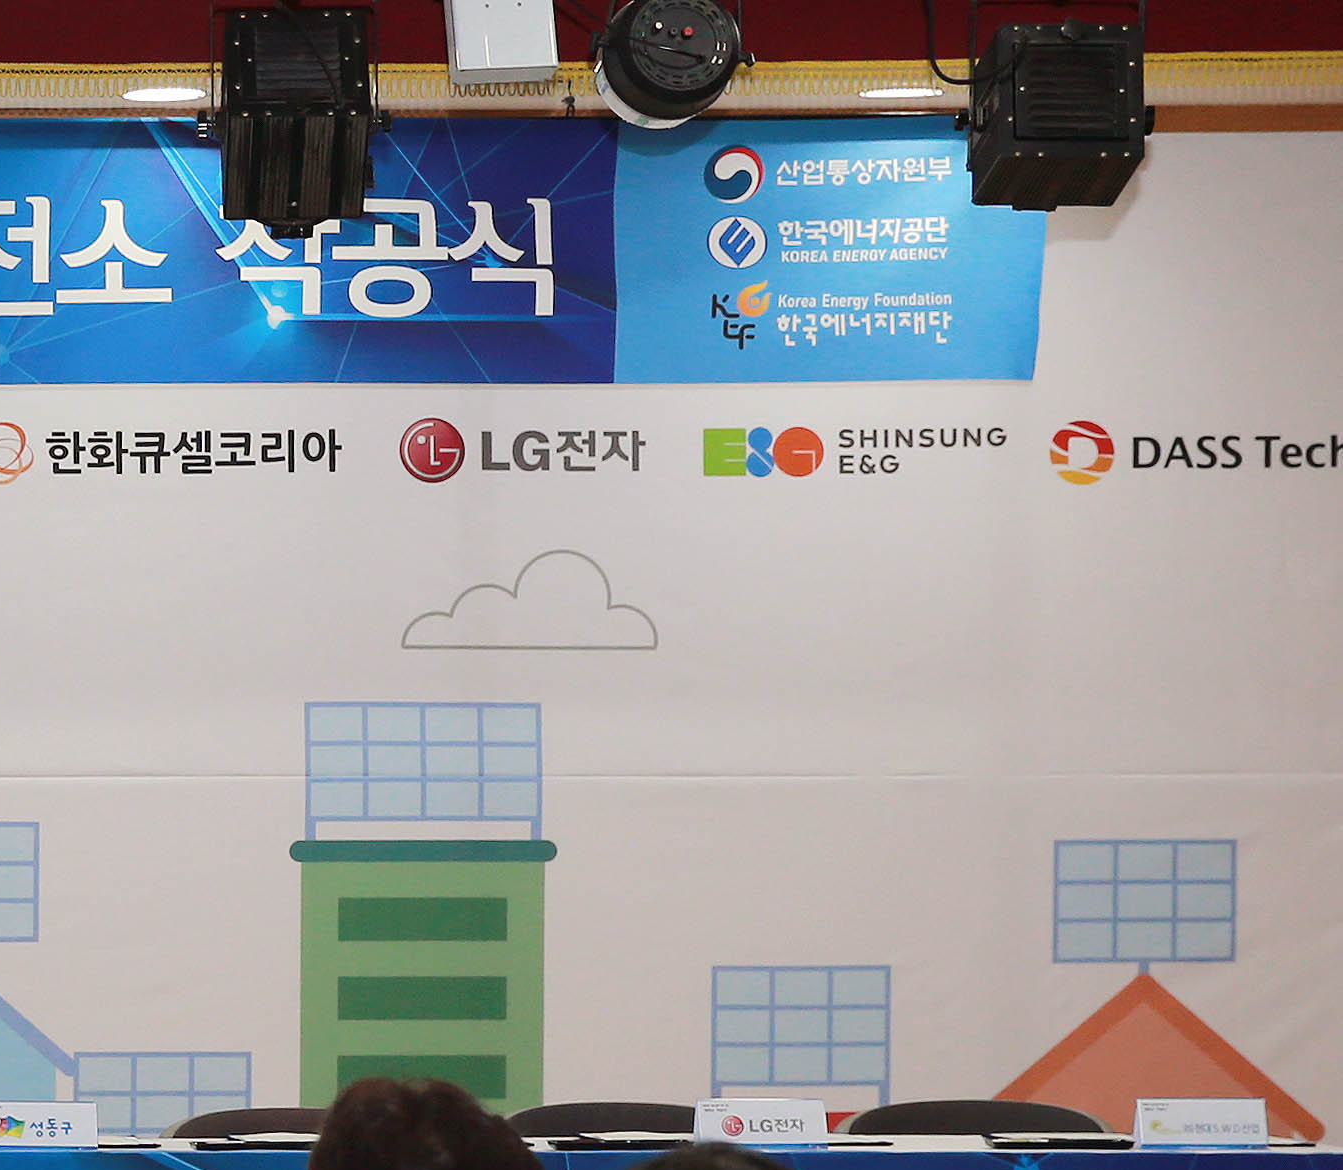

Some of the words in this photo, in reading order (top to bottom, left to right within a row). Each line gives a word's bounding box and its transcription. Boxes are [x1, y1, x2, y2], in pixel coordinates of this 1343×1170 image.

[776, 156, 953, 187] 산업통상자원부
[778, 215, 950, 249] 한국에너지공단
[781, 249, 829, 263] KOREA
[832, 248, 888, 263] ENERGY
[888, 246, 949, 261] AGENCY
[777, 294, 817, 308] Korea
[821, 293, 870, 311] Energy
[874, 291, 953, 307] Foundation
[776, 307, 953, 347] 한국에너지재단
[480, 430, 647, 472] LG전자
[838, 427, 1007, 449] SHINSUNG
[45, 428, 343, 475] 한화큐셀코리아
[839, 454, 900, 475] E&G
[1132, 435, 1243, 469] DASS
[29, 1118, 73, 1138] 성동구
[748, 1118, 805, 1133] LG전자
